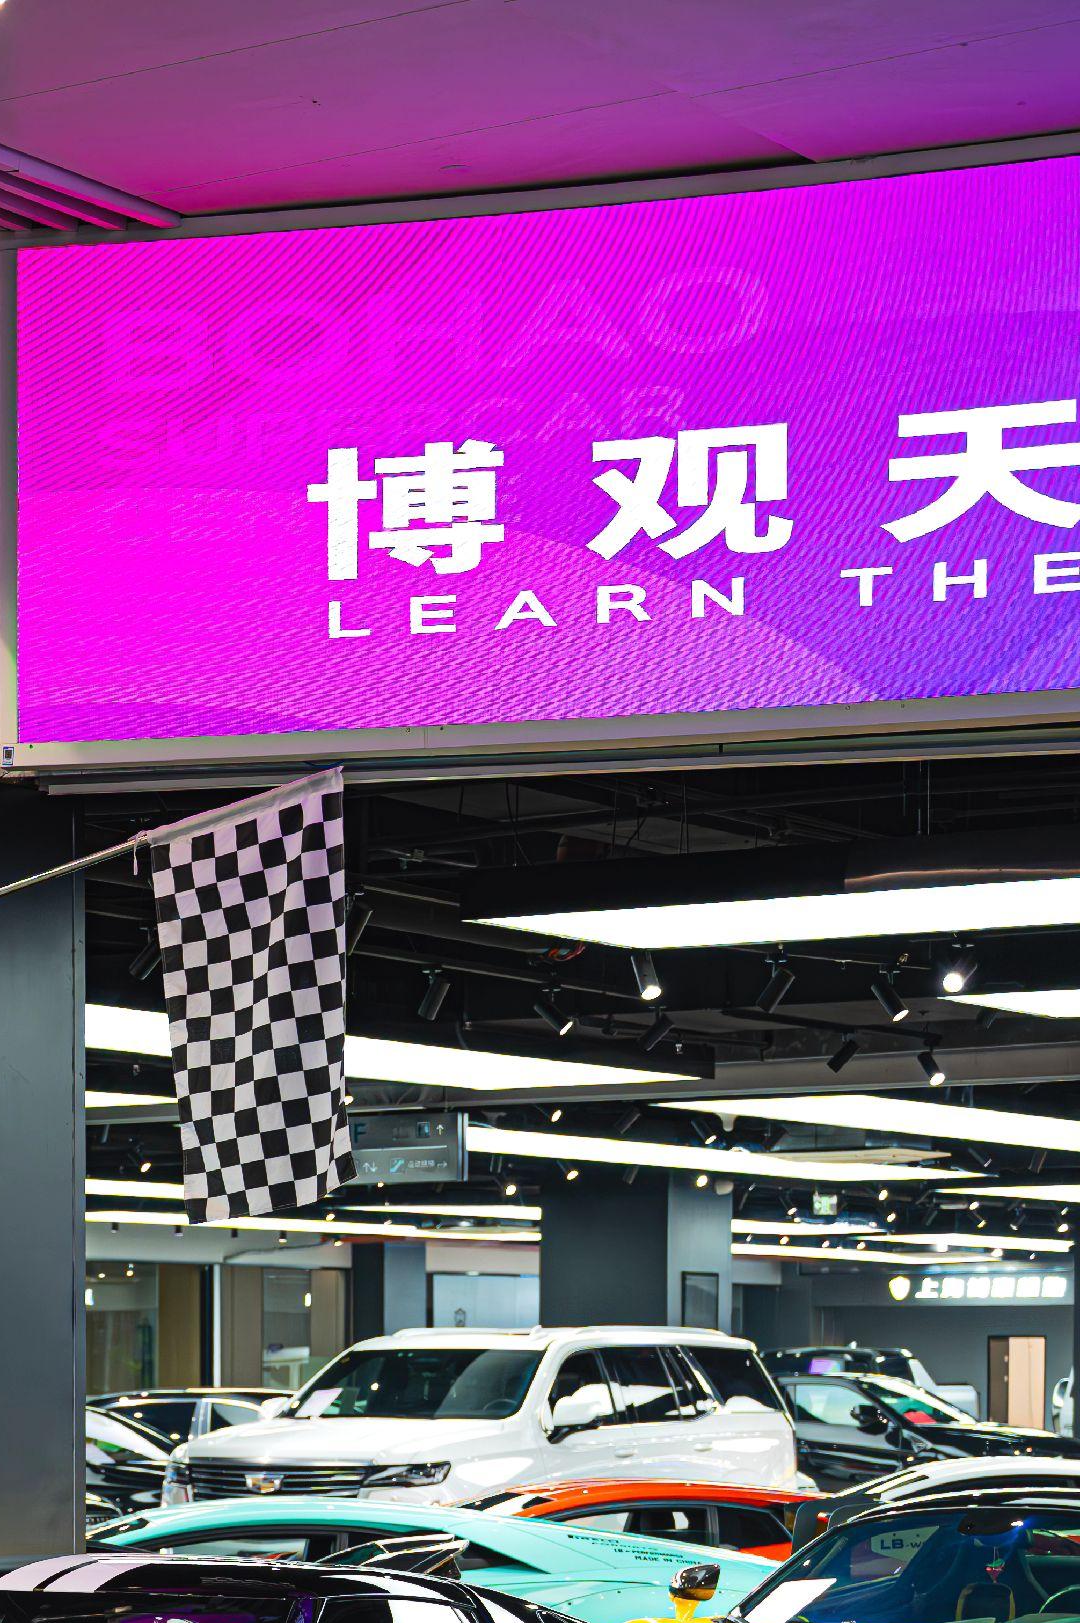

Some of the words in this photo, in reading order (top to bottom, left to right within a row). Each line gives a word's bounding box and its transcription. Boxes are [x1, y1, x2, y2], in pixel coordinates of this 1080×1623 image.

[308, 399, 1080, 580] 博观天
[328, 577, 746, 639] LEARN
[840, 552, 1080, 606] THE
